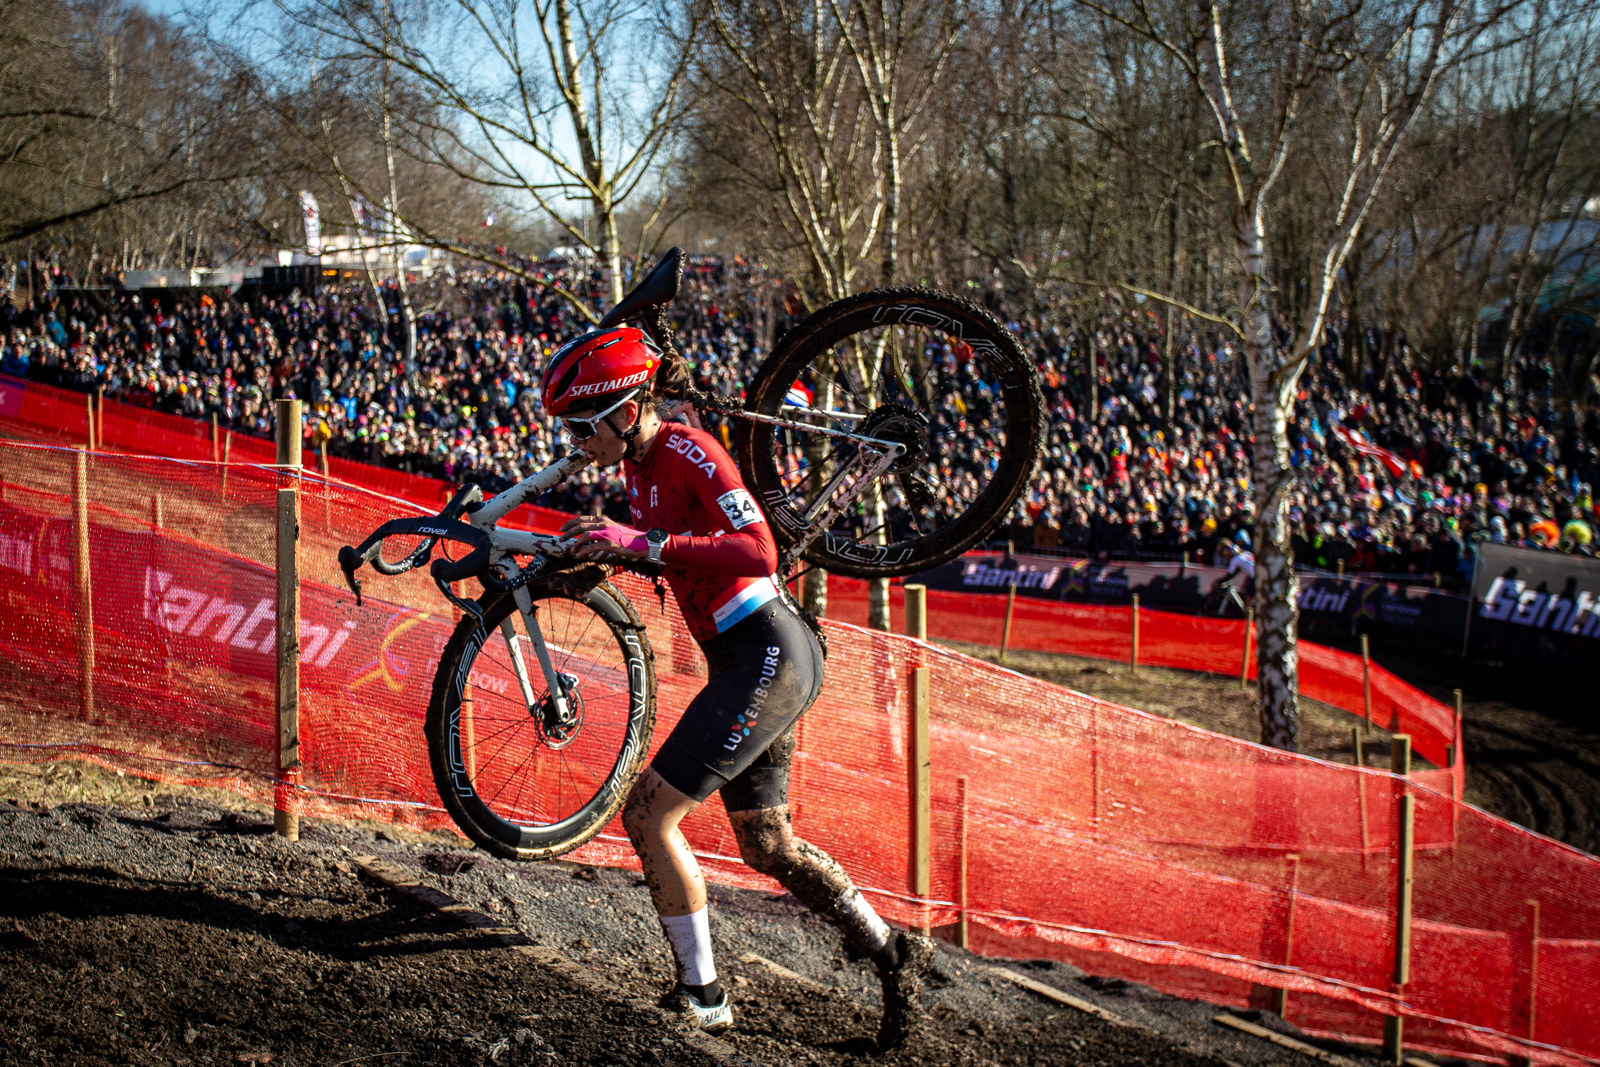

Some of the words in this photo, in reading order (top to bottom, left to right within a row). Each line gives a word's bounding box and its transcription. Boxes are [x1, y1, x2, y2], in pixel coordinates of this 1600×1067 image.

[568, 369, 649, 398] SPECIALIZED
[724, 499, 756, 521] 34
[416, 526, 449, 536] roval
[449, 625, 488, 797] roval
